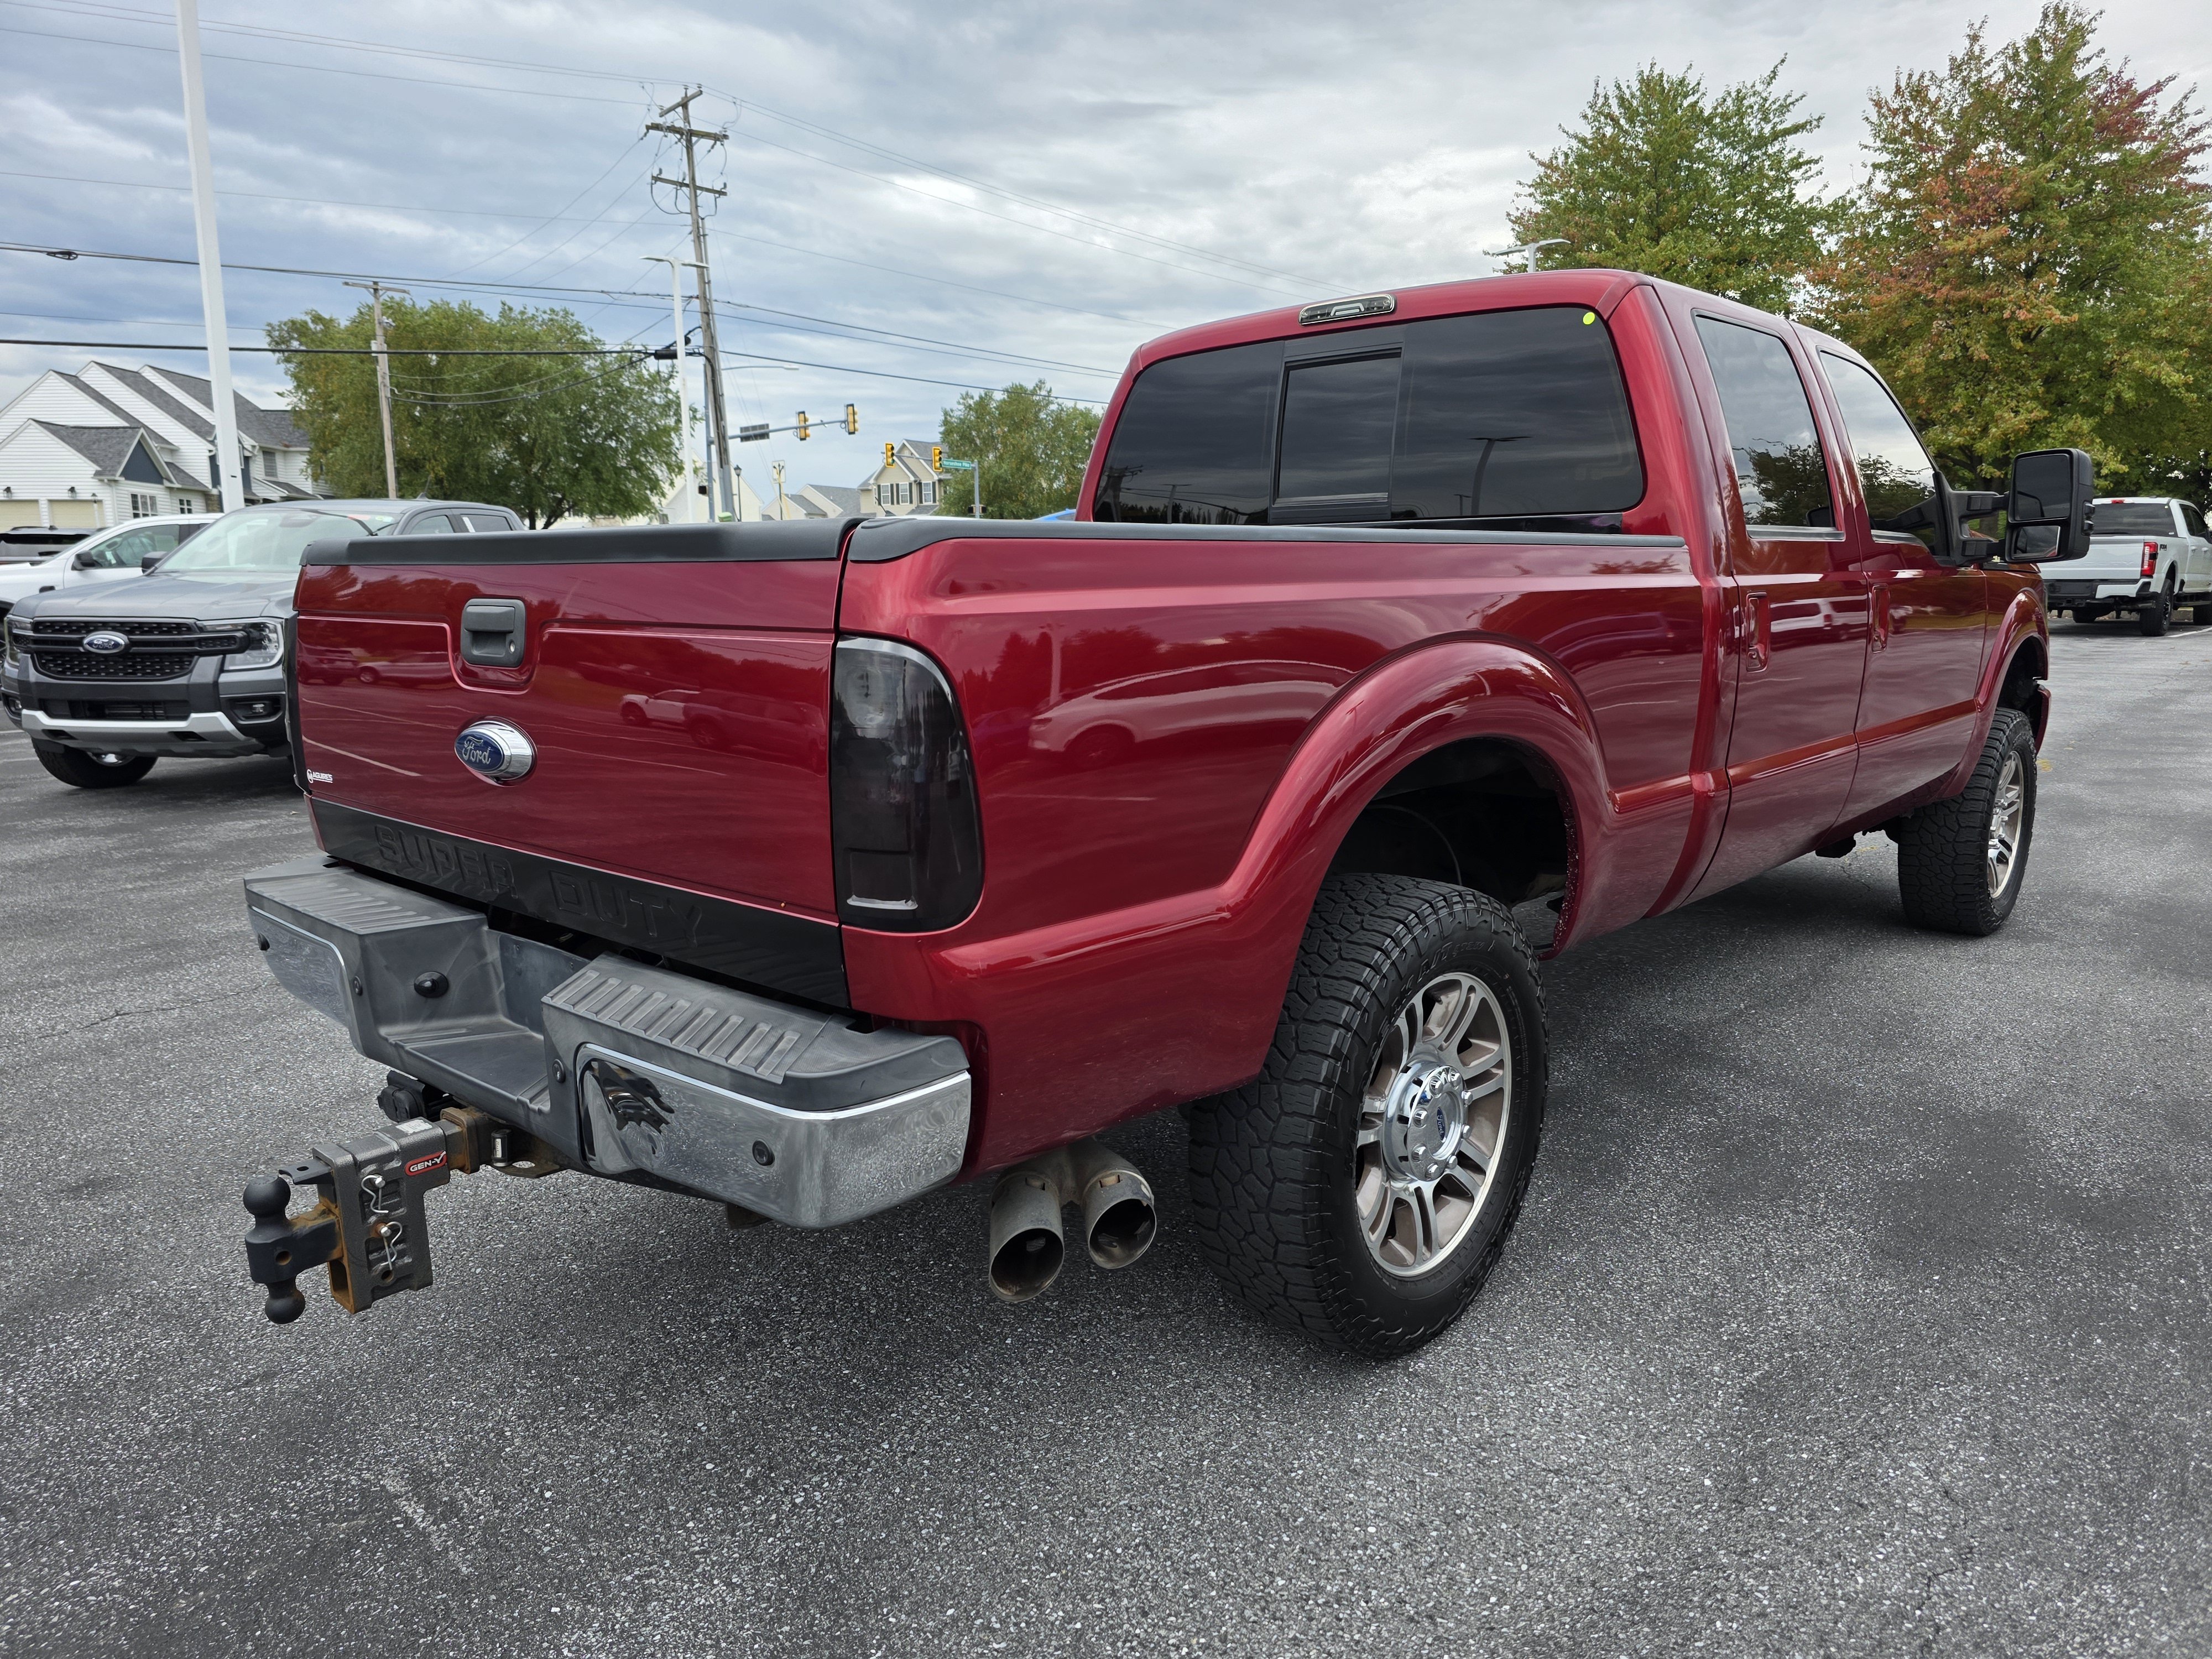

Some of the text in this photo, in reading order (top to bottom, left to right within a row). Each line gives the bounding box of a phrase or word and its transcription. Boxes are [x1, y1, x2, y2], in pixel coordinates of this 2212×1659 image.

[92, 638, 114, 649] Ford
[462, 736, 491, 765] Ford
[374, 825, 702, 947] SUPER DUTY
[410, 1151, 446, 1172] GEN-Y
